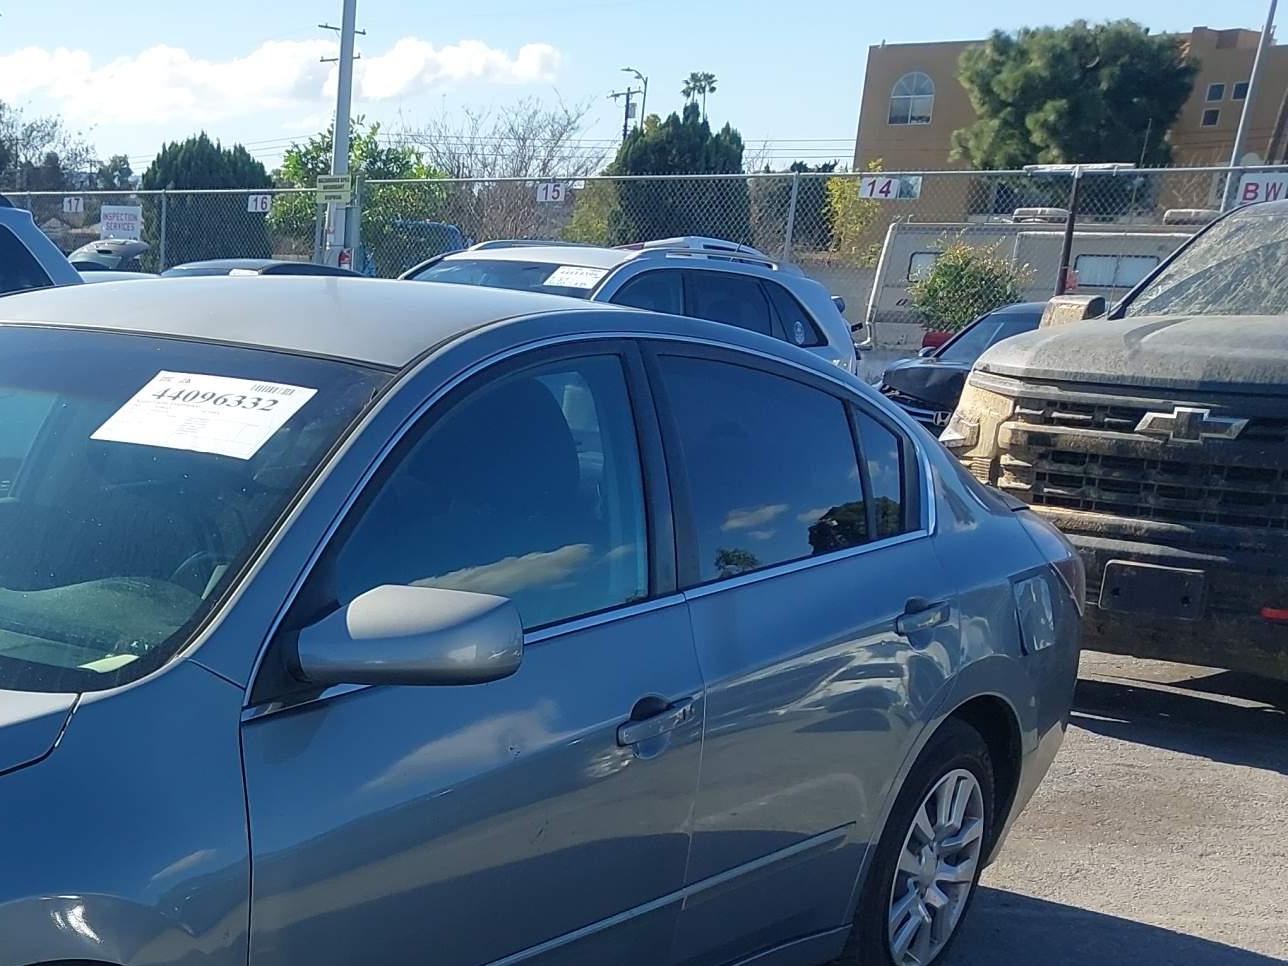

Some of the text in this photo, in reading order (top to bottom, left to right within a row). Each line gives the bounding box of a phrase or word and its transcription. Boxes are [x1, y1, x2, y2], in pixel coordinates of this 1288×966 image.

[542, 183, 561, 200] 15
[867, 179, 892, 197] 14
[68, 198, 80, 211] 17
[253, 196, 268, 210] 16
[152, 387, 279, 412] 44096332
